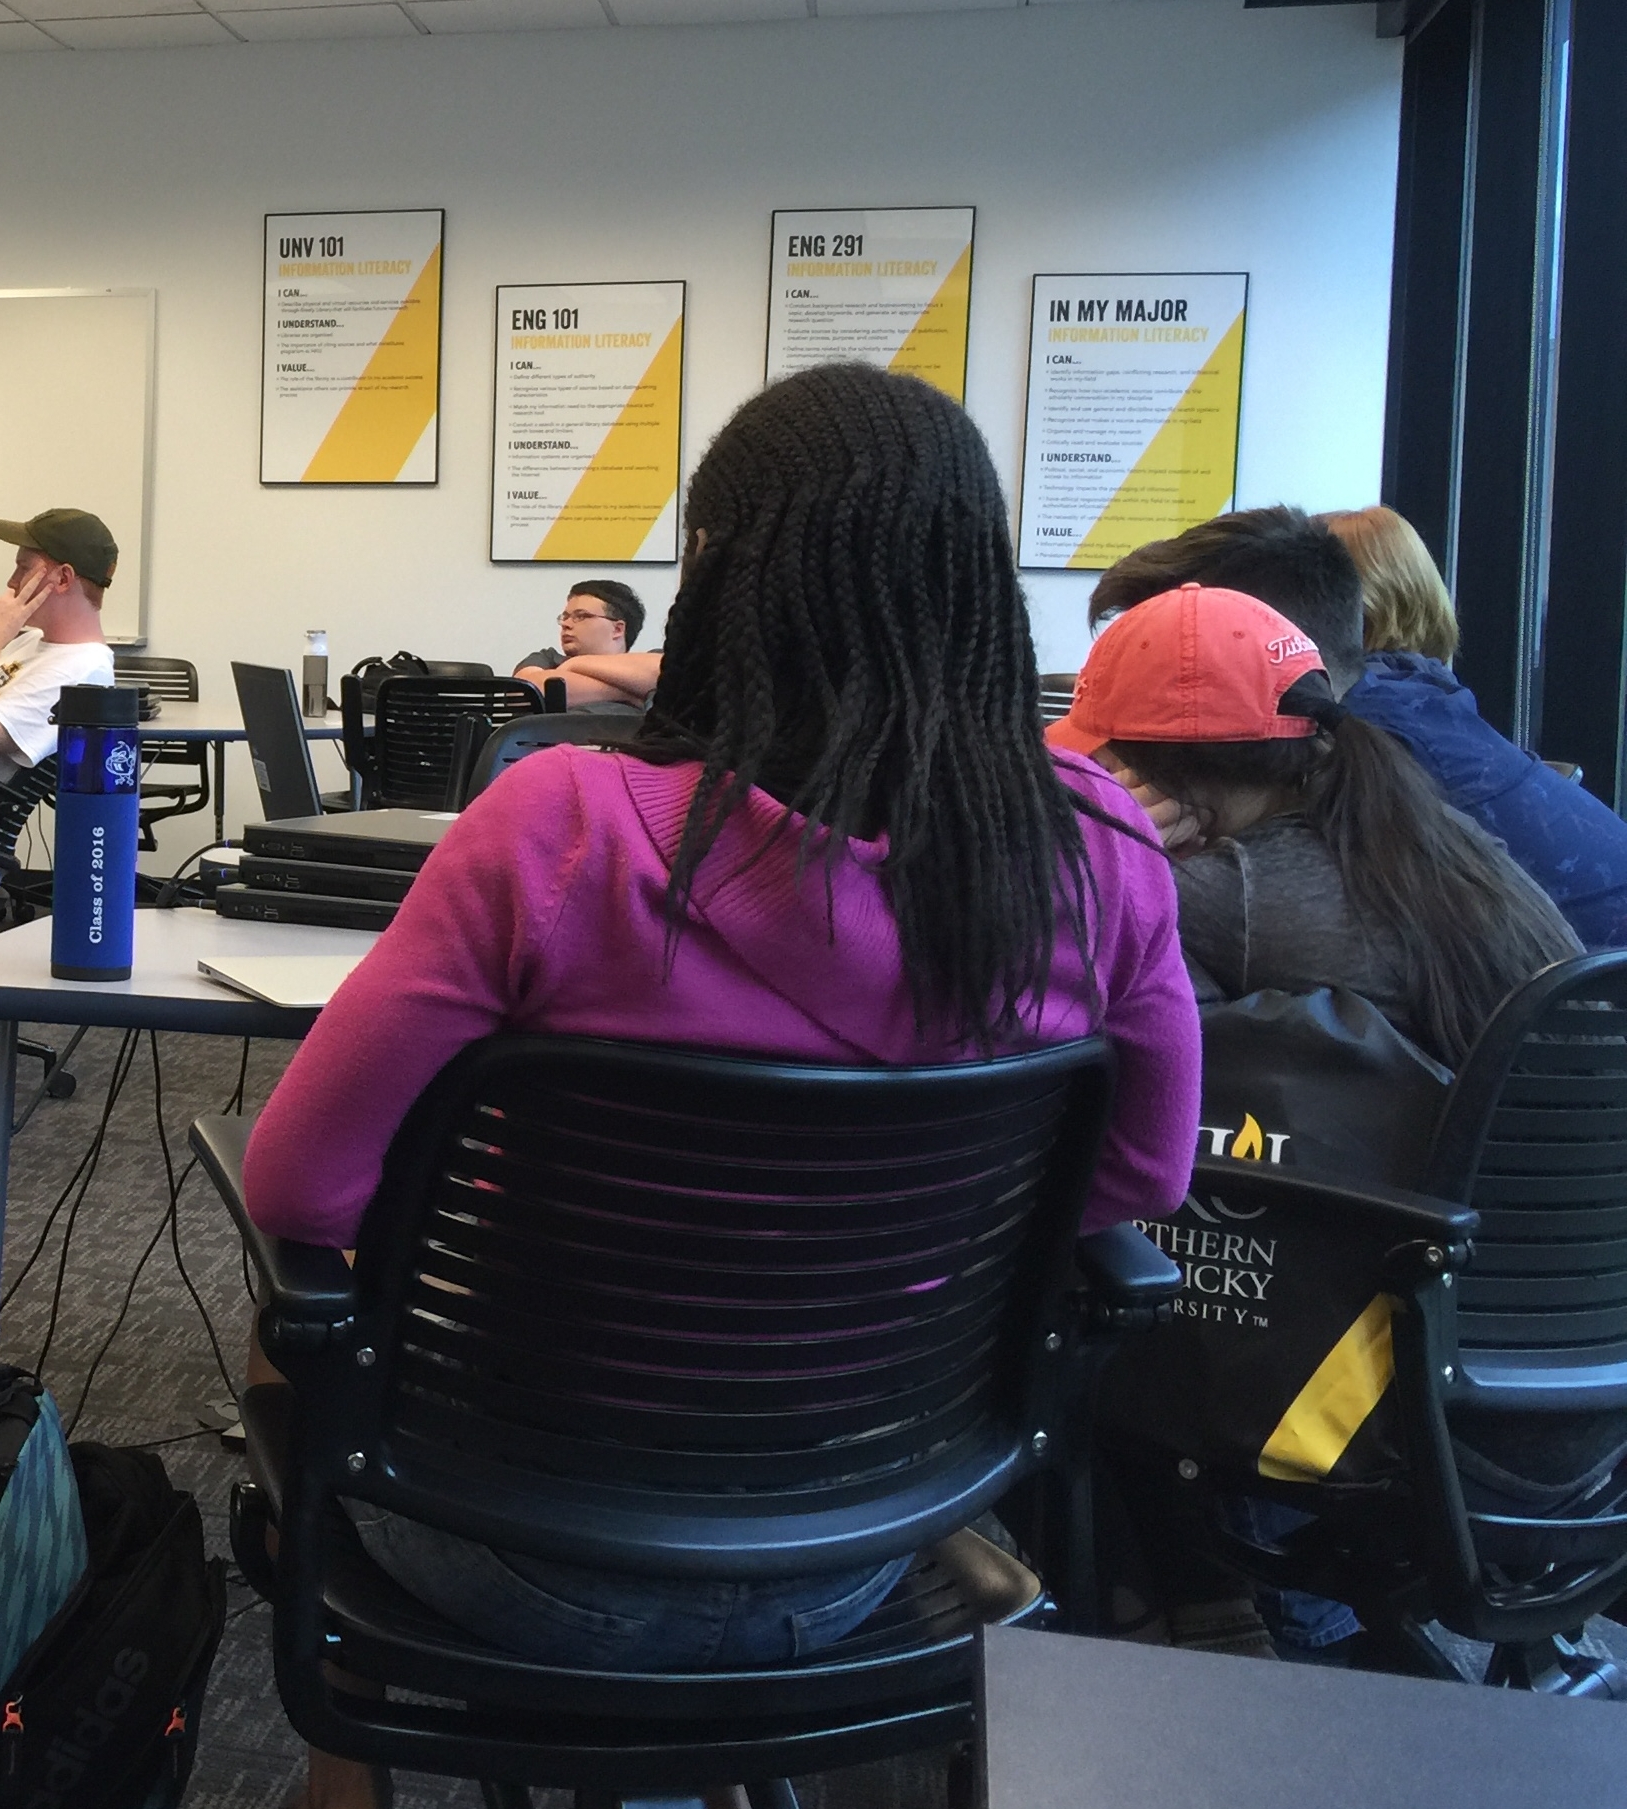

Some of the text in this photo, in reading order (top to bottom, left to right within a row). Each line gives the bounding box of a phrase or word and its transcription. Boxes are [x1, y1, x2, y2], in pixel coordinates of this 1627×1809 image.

[280, 236, 343, 258] UNV 101
[789, 235, 863, 257] ENG 291
[279, 260, 411, 277] INFORMATION LITERACY
[787, 260, 937, 277] INFORMATION LITERACY
[278, 289, 281, 298] I
[786, 289, 789, 299] I
[1050, 299, 1187, 322] IN MY MAJOR
[278, 319, 281, 329] I
[512, 309, 578, 330] ENG 101
[512, 333, 651, 350] INFORMATION LITERACY
[1049, 327, 1208, 343] INFORMATION LITERACY
[511, 361, 514, 371] I
[1047, 354, 1050, 365] I
[277, 363, 280, 373] I
[509, 441, 512, 450] I
[1041, 452, 1044, 462] I
[508, 490, 511, 500] I
[1037, 527, 1040, 537] I
[88, 826, 105, 944] Class of 2016
[1132, 1219, 1278, 1267] THERN
[1175, 1259, 1274, 1301] UCKY
